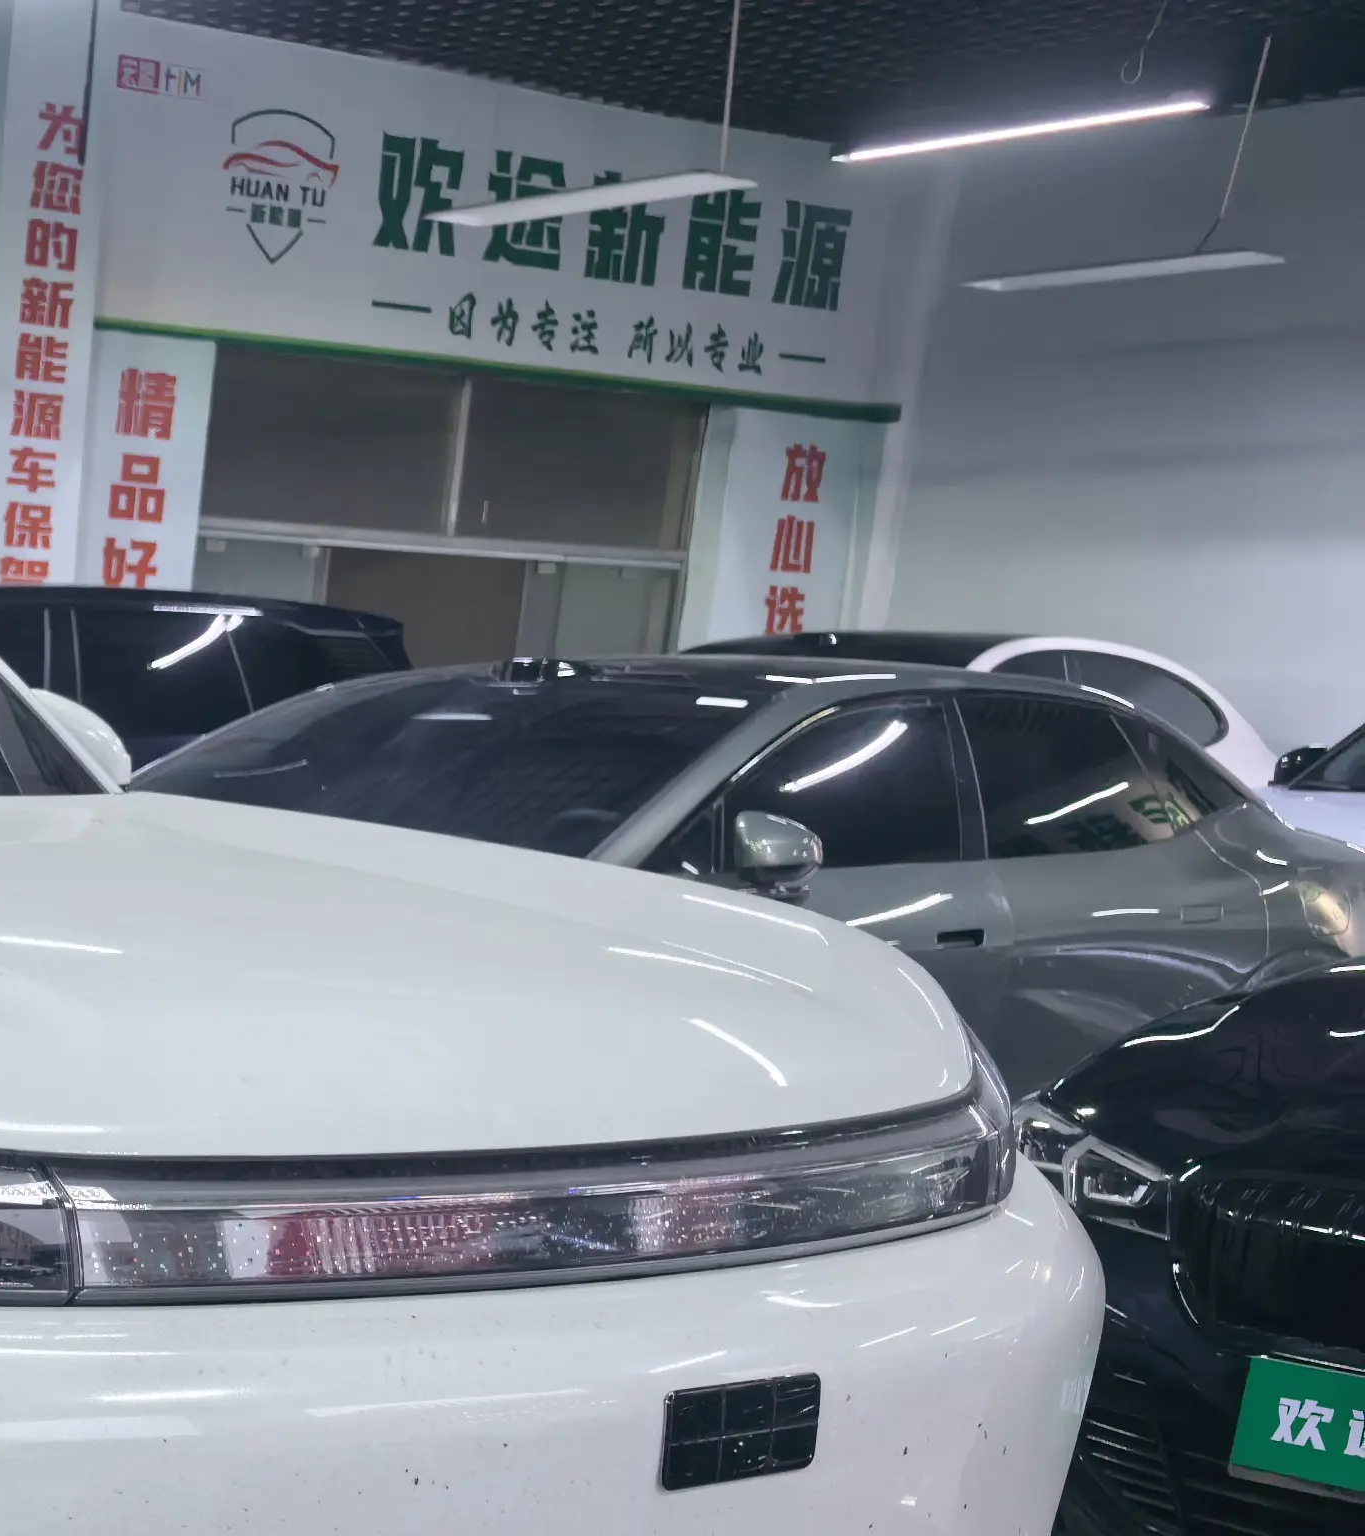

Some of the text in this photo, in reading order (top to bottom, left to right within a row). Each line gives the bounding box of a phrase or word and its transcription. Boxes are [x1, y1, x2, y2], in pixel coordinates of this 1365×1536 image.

[229, 176, 327, 207] HUAN TU
[372, 130, 852, 311] 欢途新能源
[449, 292, 765, 376] 因为专注 所以专业
[103, 368, 177, 588] 精品好
[765, 443, 826, 636] 放心选
